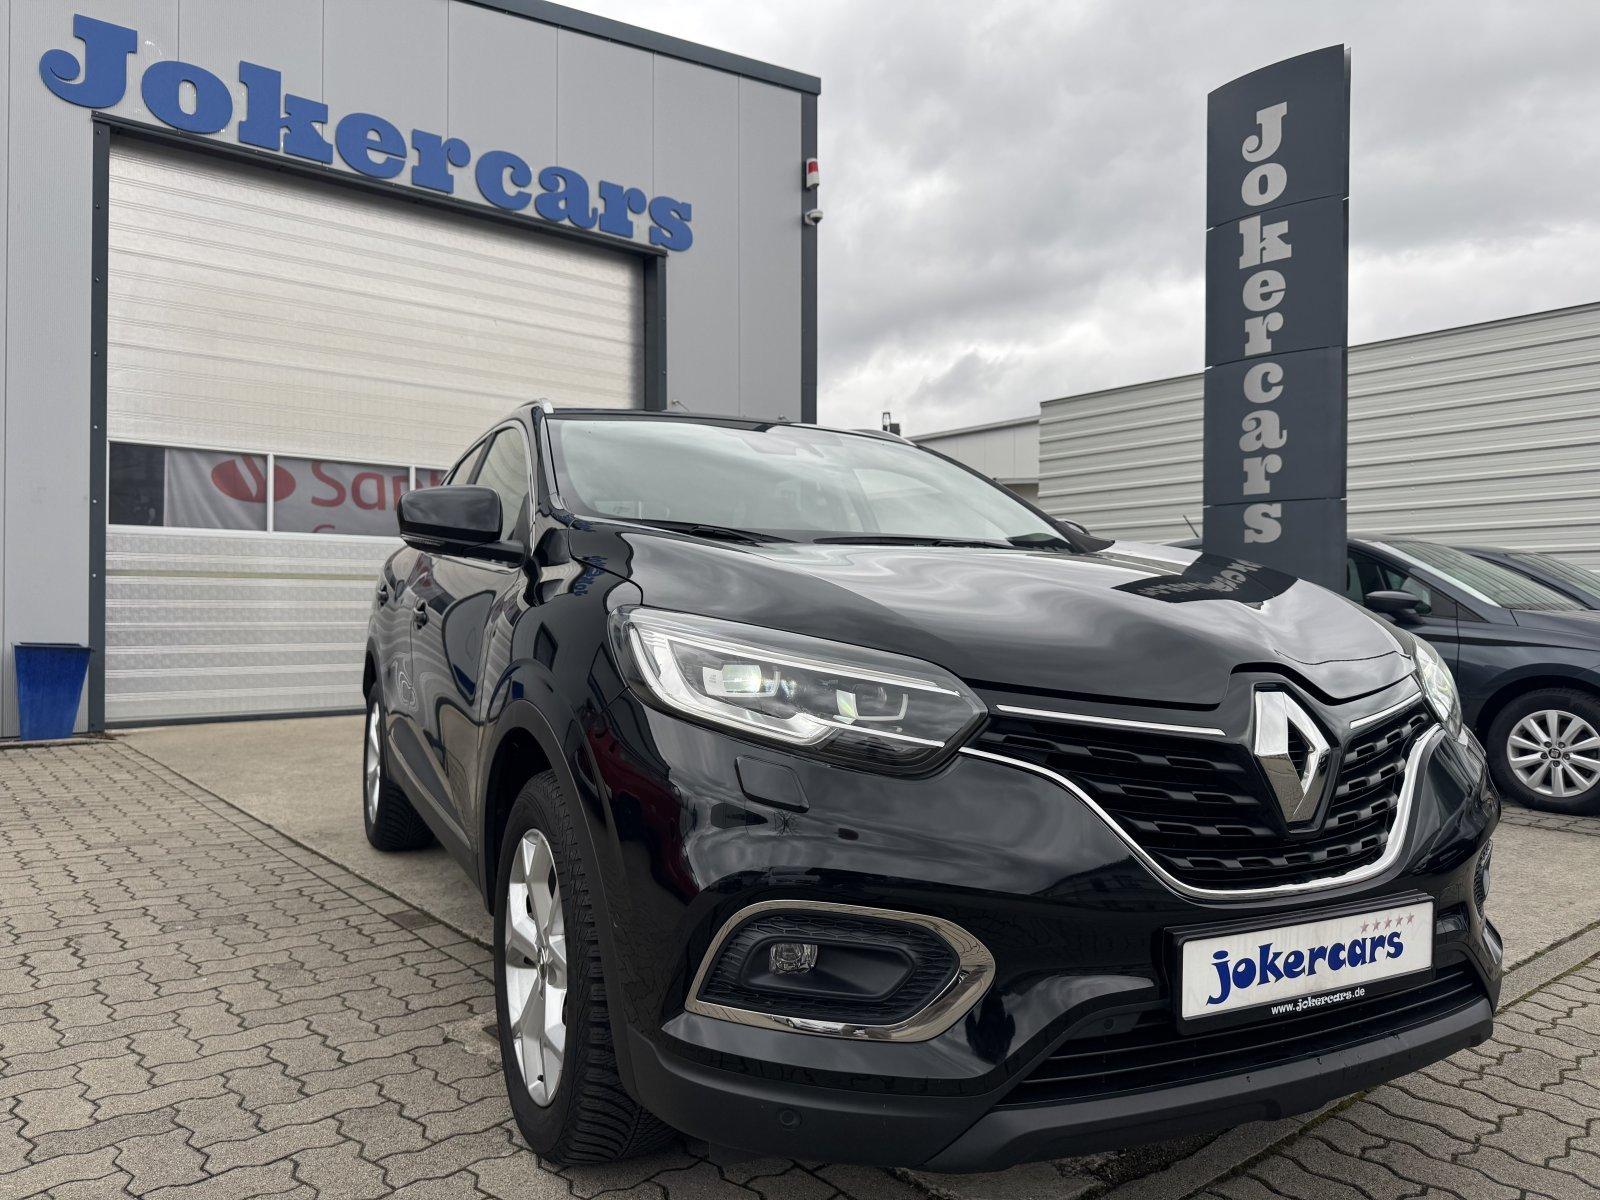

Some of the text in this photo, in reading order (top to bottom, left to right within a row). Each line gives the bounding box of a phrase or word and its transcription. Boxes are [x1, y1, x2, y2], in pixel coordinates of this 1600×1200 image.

[39, 14, 692, 251] Jokercars
[1239, 101, 1292, 544] Jokercars
[1206, 931, 1404, 1006] jokercars
[1271, 987, 1365, 1015] www.jokercars.de
